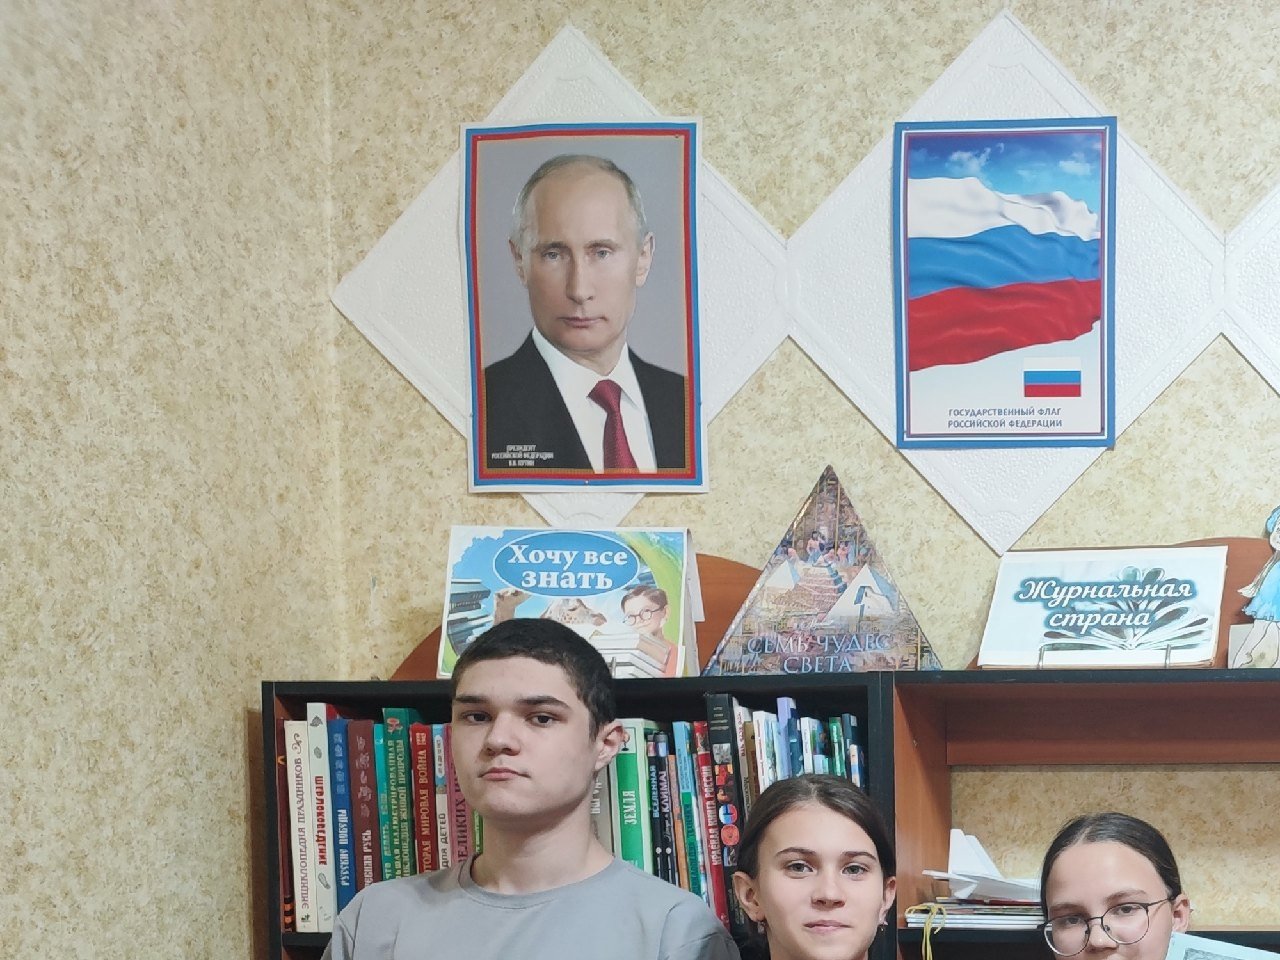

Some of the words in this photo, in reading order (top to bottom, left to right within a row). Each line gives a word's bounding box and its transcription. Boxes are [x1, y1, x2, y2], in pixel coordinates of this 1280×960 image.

[948, 407, 1035, 417] ГОСУДАРСТВЕННЫЙ
[1037, 407, 1061, 416] ФЛАГ
[948, 419, 1006, 429] РОССИЙСКОЙ
[1008, 419, 1063, 429] ФЕДЕРАЦИИ
[508, 544, 579, 571] Хочу
[584, 550, 628, 566] все
[521, 570, 613, 589] знать
[1019, 580, 1193, 609] Журнальная
[1049, 612, 1151, 634] страна
[747, 635, 808, 654] СЕМЬ
[816, 633, 891, 653] ЧУДЕС
[783, 655, 852, 674] СВЕТА
[416, 750, 428, 784] ВОЙНА
[701, 765, 715, 798] РОССИИ
[293, 757, 306, 823] ПРАЗДНИКОВ
[649, 765, 660, 818] ВСЕЛЕННАЯ
[419, 789, 431, 836] МИРОВАЯ
[622, 790, 637, 825] ЗЕМЛЯ
[359, 829, 372, 852] РУСЬ
[438, 813, 448, 844] ДЕТЕЙ
[440, 847, 449, 868] ДЛЯ
[706, 828, 721, 865] КРАСНАЯ
[298, 827, 309, 909] ЭНЦИКЛОПЕДИЯ
